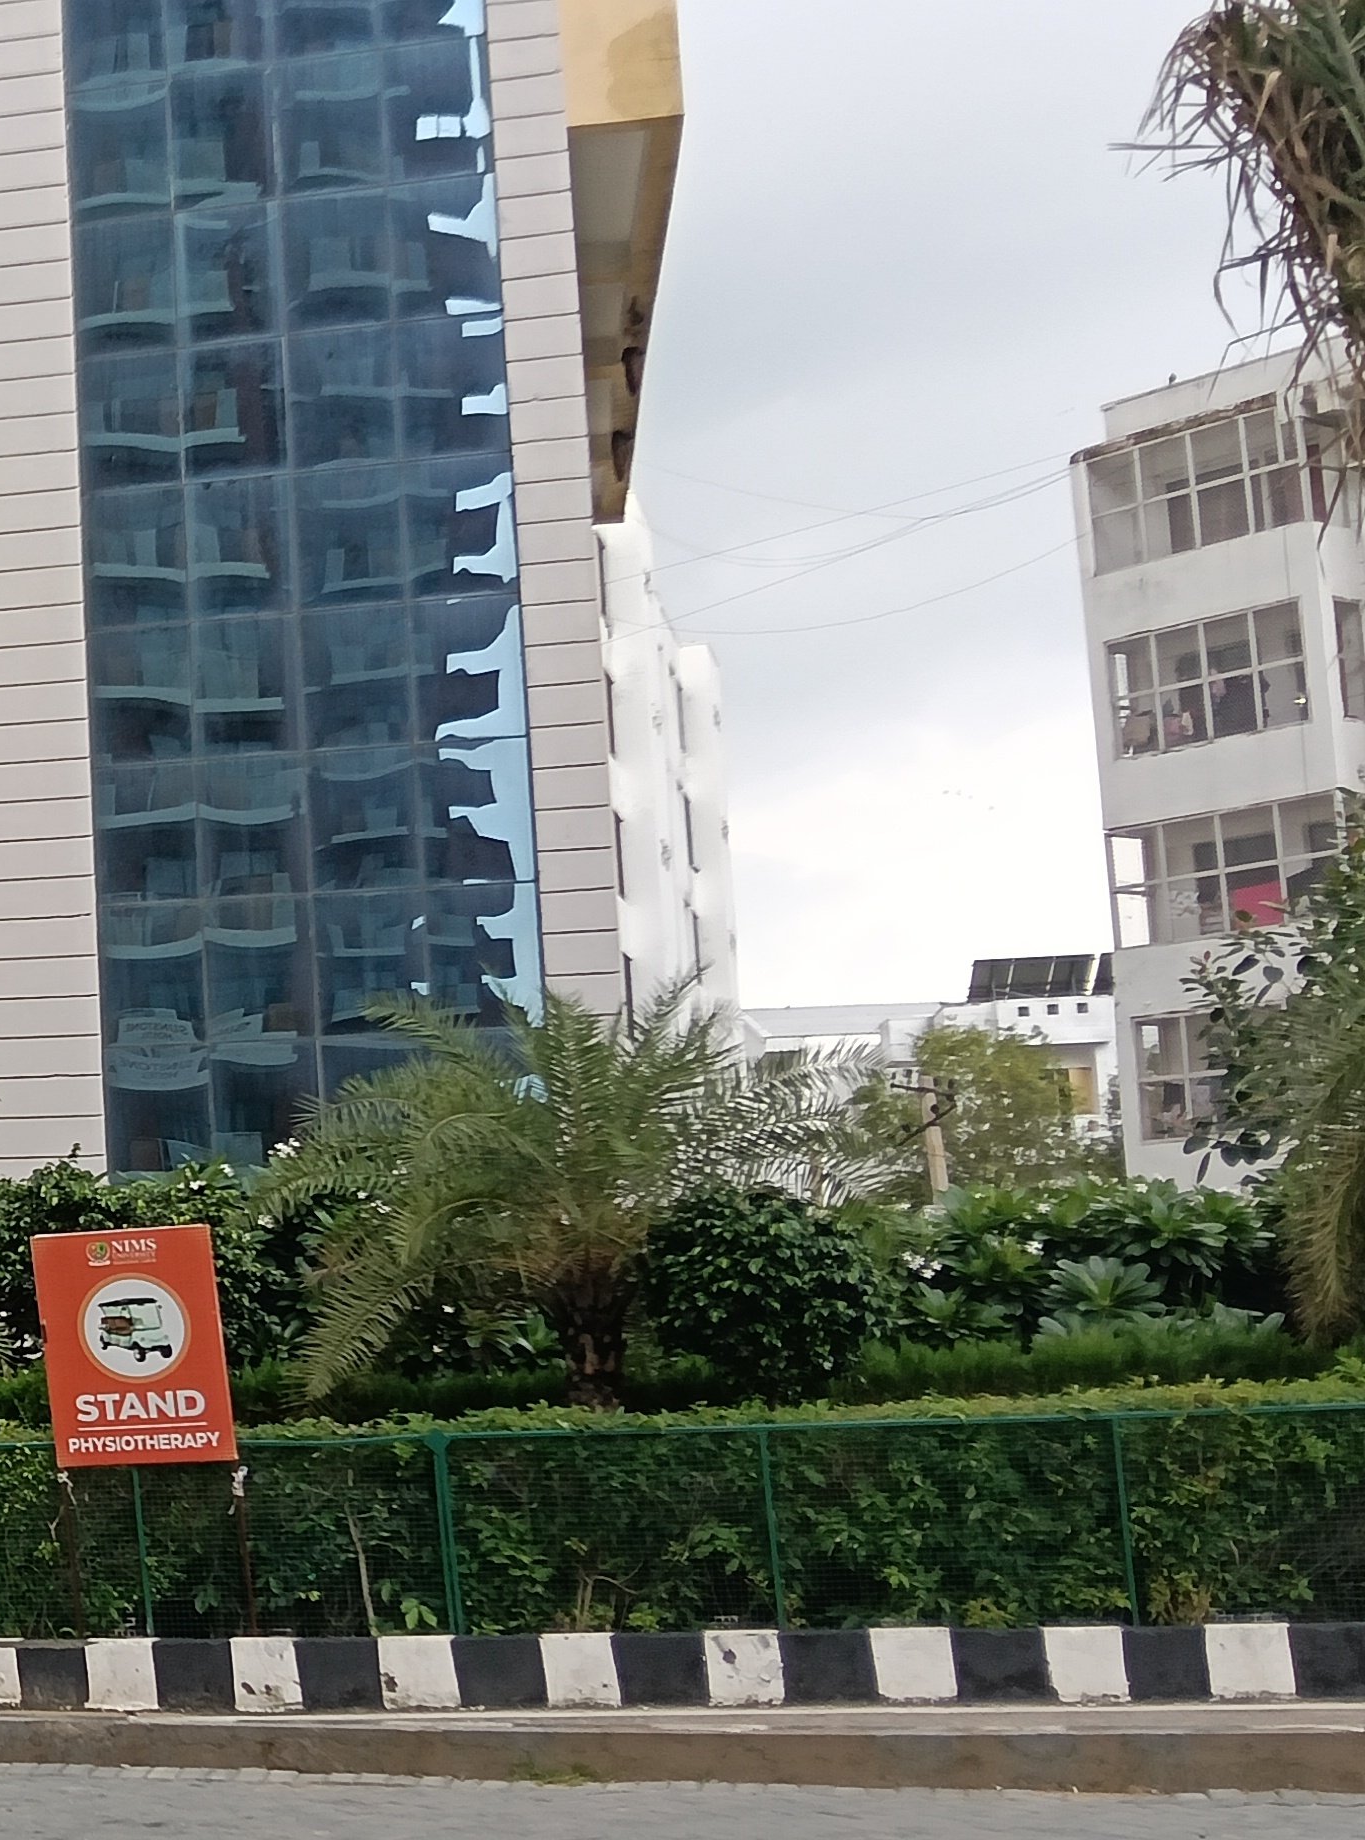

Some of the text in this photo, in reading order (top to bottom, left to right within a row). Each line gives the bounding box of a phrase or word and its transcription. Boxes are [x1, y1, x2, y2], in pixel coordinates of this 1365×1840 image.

[111, 1238, 158, 1253] NIMS
[75, 1389, 207, 1423] STAND
[68, 1431, 220, 1454] PHYSIOTHERAPY
